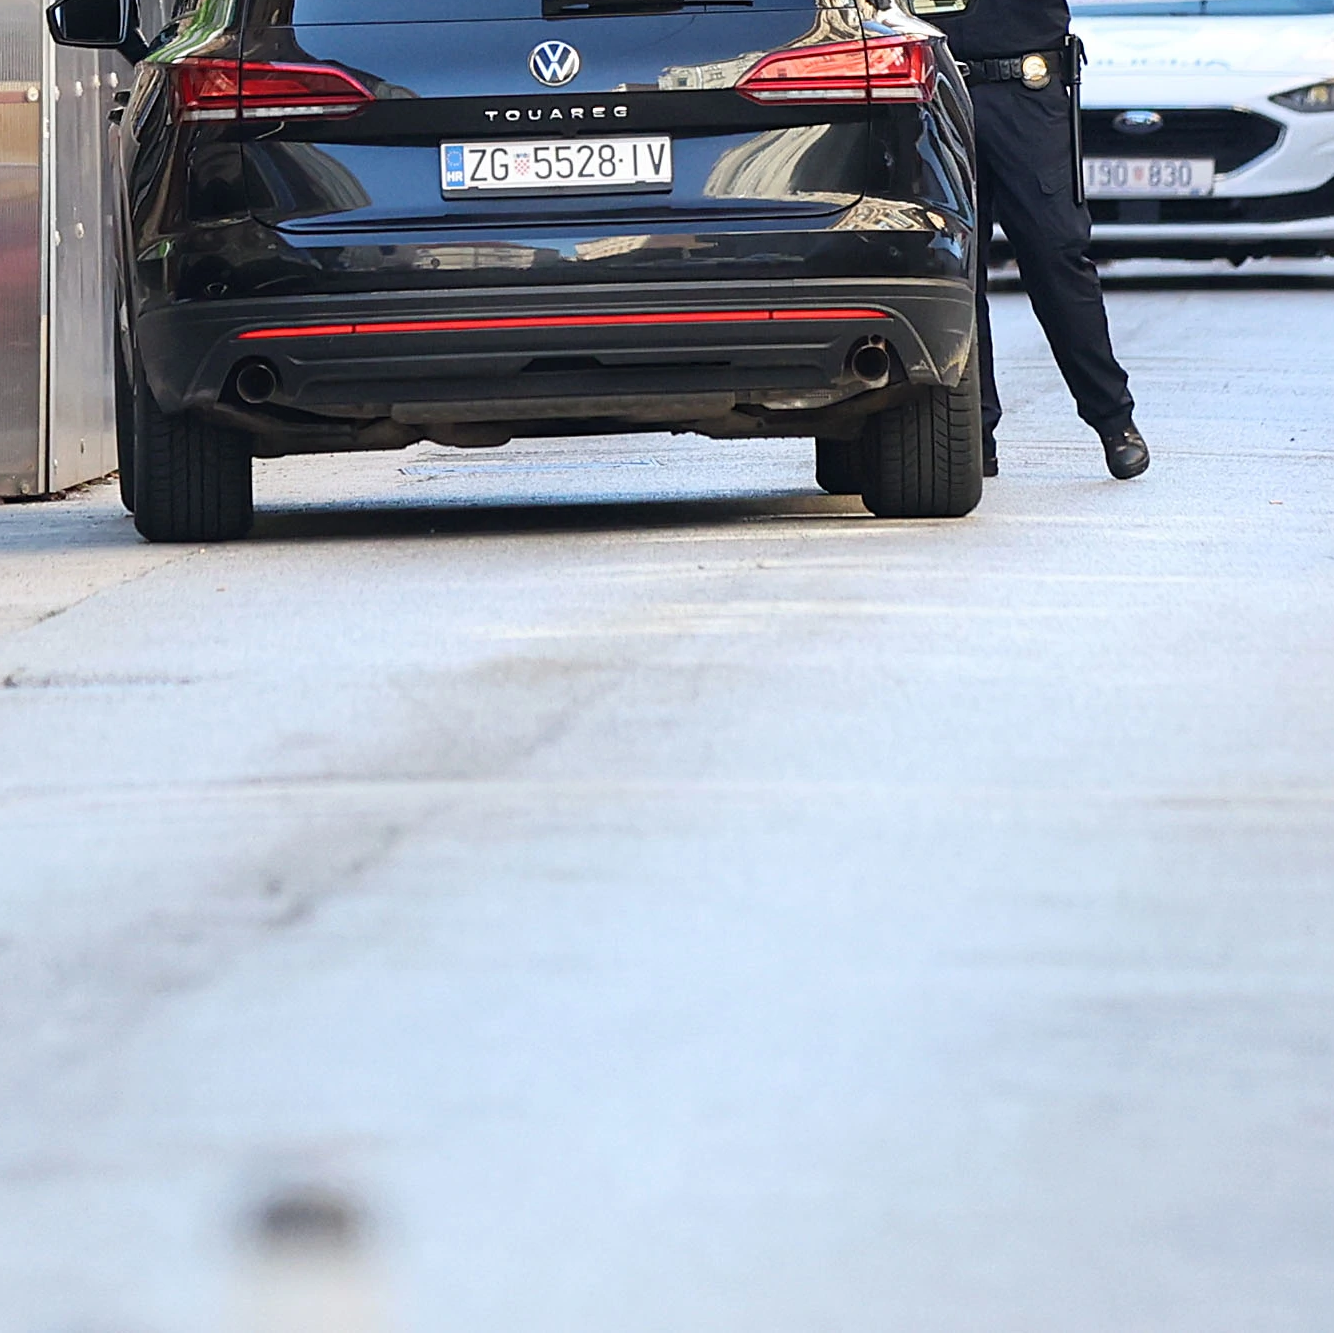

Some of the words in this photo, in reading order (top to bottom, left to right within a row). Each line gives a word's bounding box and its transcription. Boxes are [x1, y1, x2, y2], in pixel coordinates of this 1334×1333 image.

[485, 106, 628, 121] TOUAREG
[469, 148, 509, 182] ZG
[447, 170, 463, 183] HR
